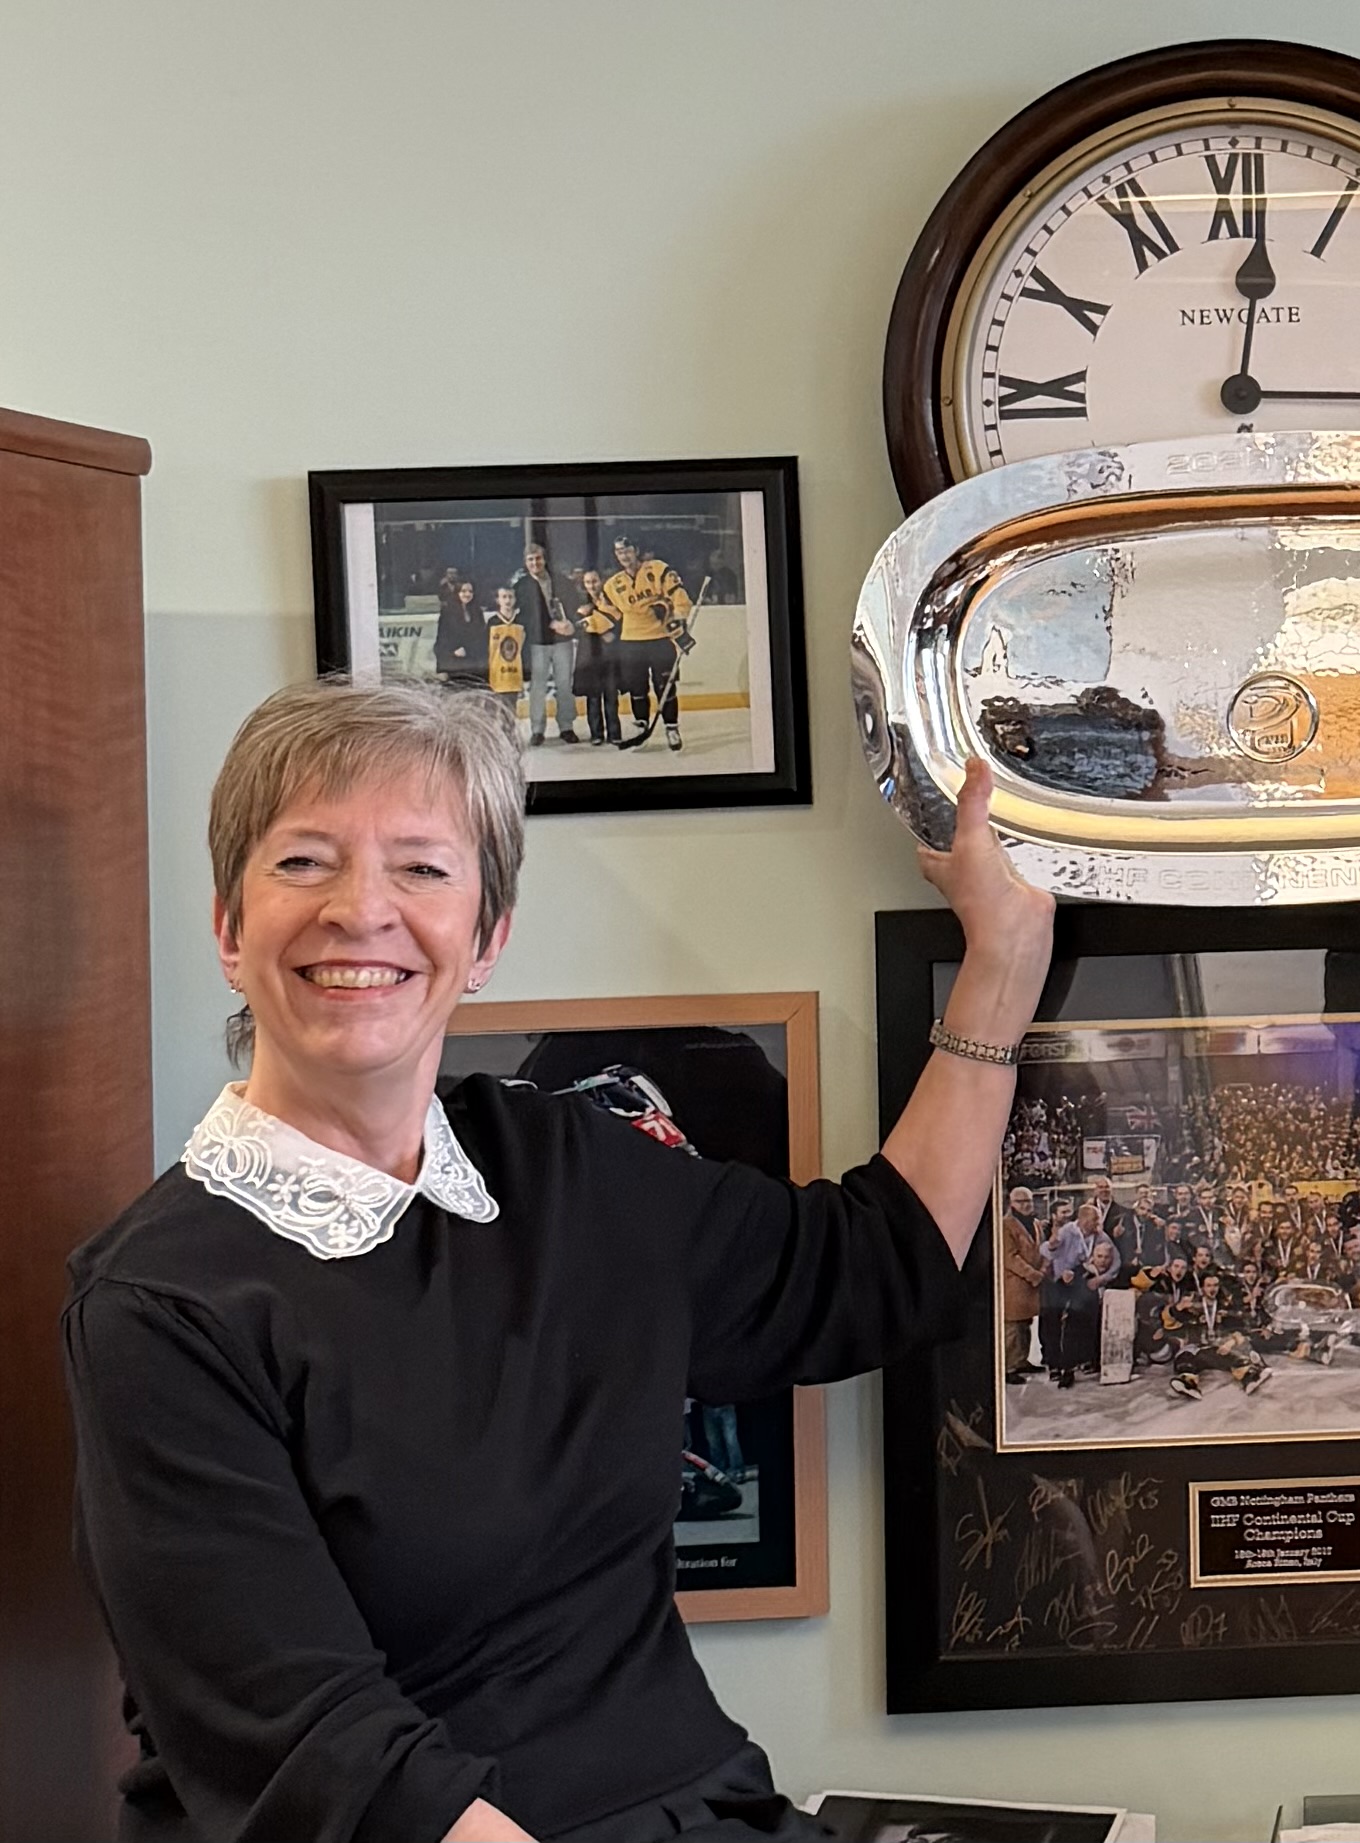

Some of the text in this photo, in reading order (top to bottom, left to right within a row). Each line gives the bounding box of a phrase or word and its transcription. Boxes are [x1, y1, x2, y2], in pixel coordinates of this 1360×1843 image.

[1095, 174, 1183, 280] XI
[1016, 263, 1113, 344] X
[1179, 307, 1300, 325] NEWGATE
[999, 365, 1088, 424] IX
[1240, 1494, 1305, 1507] Nottingham
[1306, 1492, 1355, 1504] Panthers
[1210, 1510, 1355, 1528] IIHF Continental Cup
[1243, 1527, 1323, 1543] Champions
